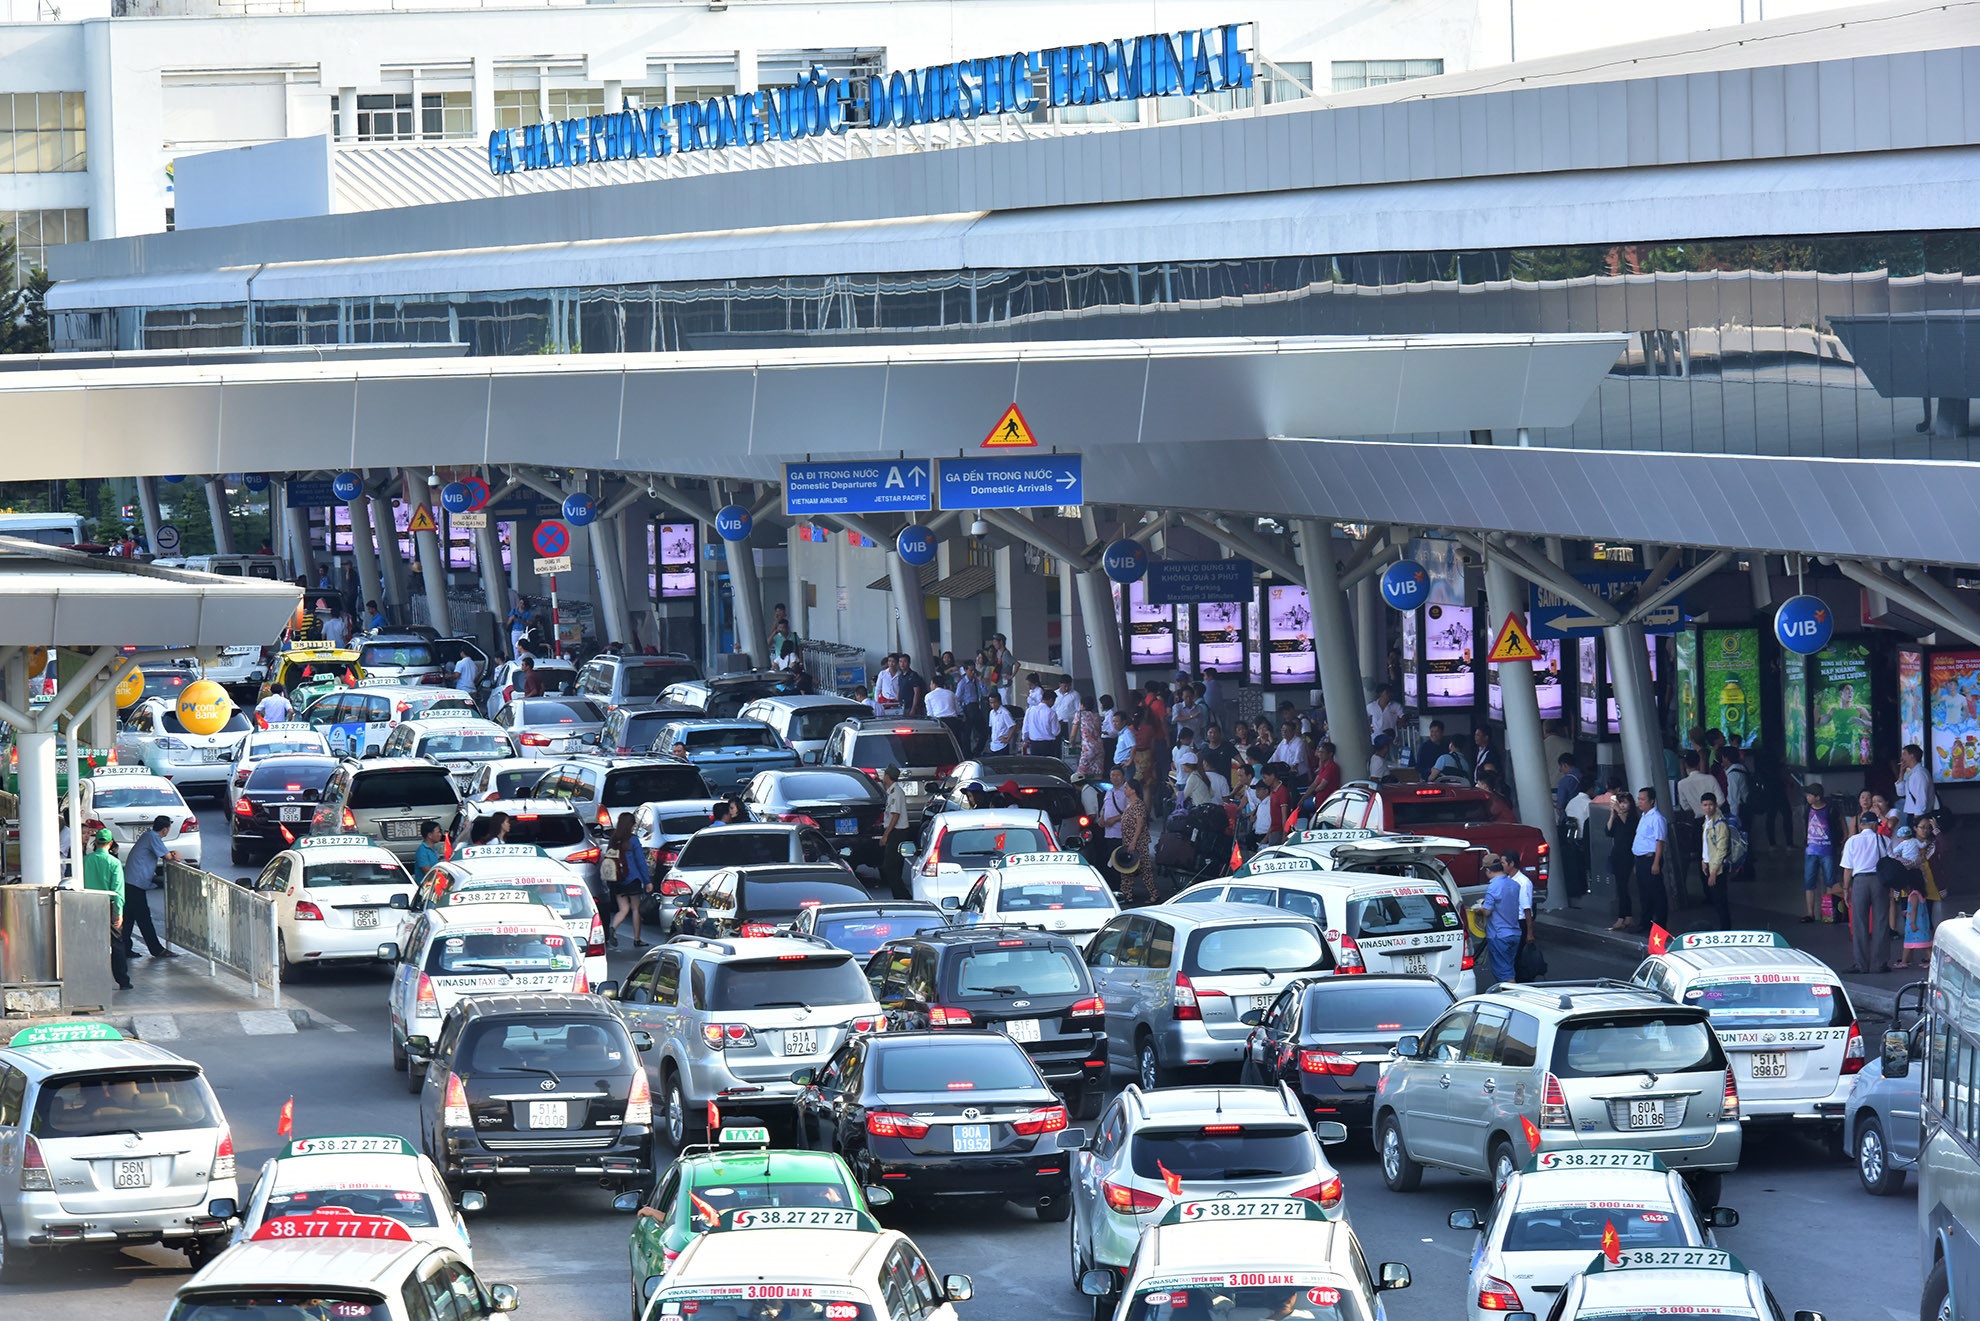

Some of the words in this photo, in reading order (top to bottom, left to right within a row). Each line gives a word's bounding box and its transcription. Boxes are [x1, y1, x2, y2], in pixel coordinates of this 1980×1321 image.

[672, 93, 765, 154] TRONG
[866, 51, 1040, 129] DOMESTIC
[1042, 22, 1252, 109] TERMINAL
[790, 472, 805, 481] GA
[806, 471, 814, 480] ĐI
[815, 470, 851, 481] TRONG
[852, 466, 880, 480] NƯỚC
[885, 466, 905, 489] A
[946, 473, 961, 483] GA
[963, 469, 984, 482] ĐẾN
[986, 470, 1023, 481] TRONG
[1024, 468, 1053, 480] NƯỚC
[336, 483, 354, 491] VIB
[790, 482, 830, 491] Domestic
[831, 480, 878, 491] Departures
[971, 484, 1015, 495] Domestic
[1016, 484, 1053, 494] Arrivals
[445, 494, 463, 503] VIB
[819, 496, 848, 505] AIRLINES
[874, 494, 902, 503] JETSTAR
[902, 493, 927, 502] PACIFIC
[567, 507, 587, 516] VIB
[720, 520, 742, 530] VIB
[903, 542, 927, 553] VIB
[1109, 556, 1135, 570] VIB
[1225, 563, 1237, 571] XE
[1387, 579, 1417, 597] VIB
[1783, 620, 1818, 638] VIB
[195, 710, 218, 720] Bank
[140, 766, 149, 774] 27
[282, 814, 300, 822] 1315
[316, 837, 340, 845] 38.27
[1317, 831, 1343, 840] 38.27
[1345, 831, 1356, 839] 27
[1359, 831, 1370, 839] 27
[480, 846, 506, 855] 38.27
[507, 846, 520, 854] 27
[522, 846, 534, 854] 27
[1024, 854, 1050, 862] 38.27
[1053, 854, 1064, 862] 27
[1067, 854, 1078, 862] 27
[1264, 862, 1287, 871] 38.27
[1288, 861, 1297, 869] 27
[1299, 860, 1309, 868] 27
[515, 876, 536, 885] 3.000
[468, 891, 496, 901] 38.27
[499, 891, 512, 901] 27
[514, 891, 527, 900] 27
[358, 910, 374, 918] 56M
[356, 918, 378, 927] 0518
[579, 921, 589, 929] 27
[496, 925, 519, 934] 3.000
[1424, 934, 1445, 944] 38.27
[1447, 933, 1455, 941] 27
[1705, 933, 1738, 945] 38.27
[1741, 933, 1756, 944] 27
[1757, 933, 1772, 944] 27
[516, 976, 545, 986] 38.27
[547, 976, 560, 985] 27
[562, 975, 574, 984] 27
[1754, 973, 1780, 983] 3.000
[1014, 1020, 1030, 1030] 51F
[28, 1031, 69, 1042] 54.27
[70, 1030, 90, 1040] 27
[90, 1029, 108, 1038] 27
[791, 1031, 810, 1042] 51A
[1737, 1033, 1758, 1042] TAXI
[1780, 1031, 1812, 1042] 38.27
[1816, 1030, 1830, 1041] 27
[1832, 1030, 1846, 1040] 27
[1759, 1054, 1778, 1065] 51A
[1753, 1064, 1785, 1077] 398.67
[538, 1103, 558, 1115] 51A
[1636, 1101, 1657, 1114] 60A
[1630, 1113, 1665, 1126] 081.86
[961, 1125, 983, 1139] 80A
[318, 1139, 357, 1151] 38.27
[362, 1139, 378, 1150] 27
[382, 1139, 399, 1150] 27
[1565, 1153, 1606, 1166] 38.27
[1611, 1153, 1629, 1166] 27
[1633, 1153, 1651, 1165] 27
[121, 1160, 144, 1173] 56N
[118, 1172, 147, 1186] 0831
[1210, 1202, 1255, 1216] 38.27
[1260, 1202, 1279, 1216] 27
[1284, 1202, 1303, 1215] 27
[760, 1210, 805, 1224] 38.27
[810, 1211, 830, 1225] 27
[834, 1211, 854, 1225] 27
[1642, 1214, 1670, 1222] 5428
[270, 1221, 330, 1237] 38.77
[336, 1221, 362, 1237] 77
[368, 1221, 395, 1237] 77
[1633, 1252, 1679, 1265] 38.27
[1684, 1252, 1704, 1265] 27
[1708, 1252, 1728, 1266] 27
[1147, 1277, 1180, 1286] VINASUN
[1229, 1273, 1265, 1286] 3.000
[1283, 1275, 1294, 1284] XE
[667, 1288, 698, 1296] VINASUN
[747, 1285, 784, 1298] 3.000
[802, 1287, 813, 1298] XE
[1310, 1290, 1340, 1304] 7103
[338, 1304, 367, 1316] 1154
[825, 1305, 857, 1319] 6206
[1659, 1305, 1694, 1314] 3.000
